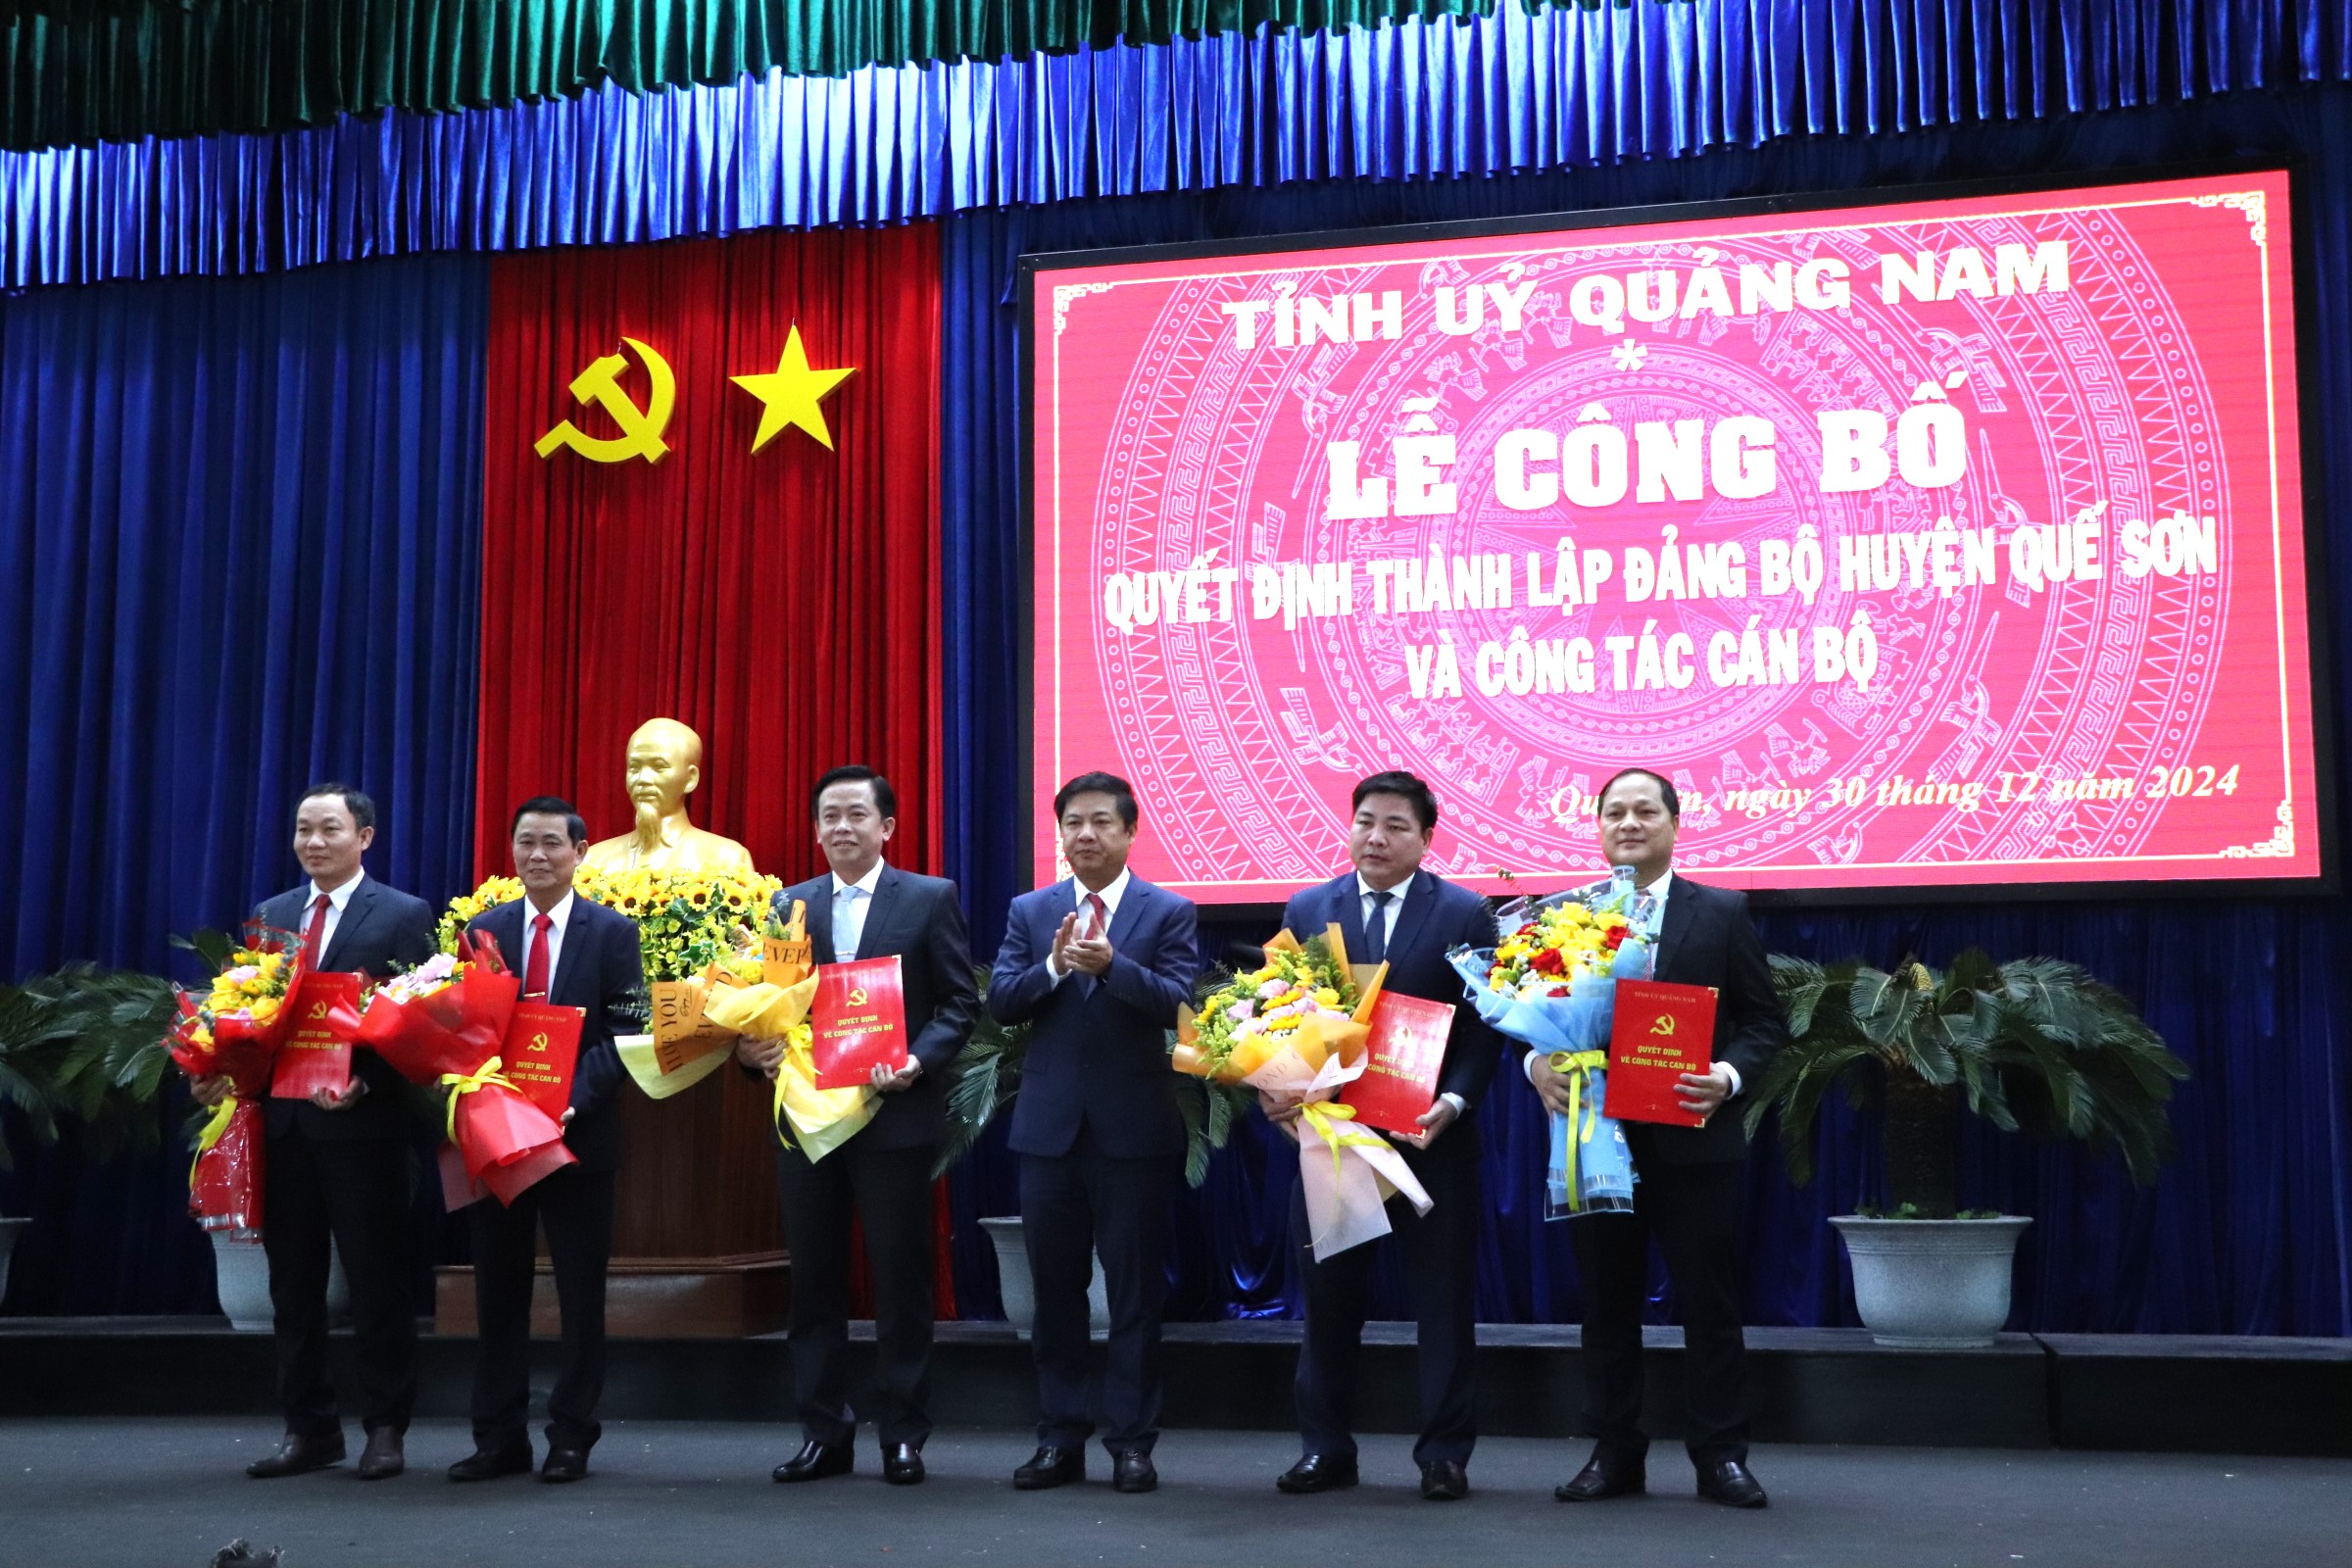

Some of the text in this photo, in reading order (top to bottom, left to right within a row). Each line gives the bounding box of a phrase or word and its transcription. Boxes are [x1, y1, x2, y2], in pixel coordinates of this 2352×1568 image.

[1222, 241, 2069, 350] TỈNH UỶ QUẢNG NAM
[1324, 370, 1968, 519] LỄ CÔNG BỐ
[1104, 500, 2216, 635] QUYẾT ĐỊNH THÀNH LẬP ĐẢNG BỘ HUYỆN QUẾ SƠN
[1404, 610, 1878, 698] VÀ CÔNG TÁC CÁN BỘ
[1724, 780, 1811, 818] ngày
[1824, 777, 1866, 808] 30
[1876, 770, 1983, 812] tháng
[1996, 771, 2039, 802] 12
[2049, 771, 2133, 803] năm
[2146, 765, 2238, 797] 2024
[661, 989, 677, 1028] YOU
